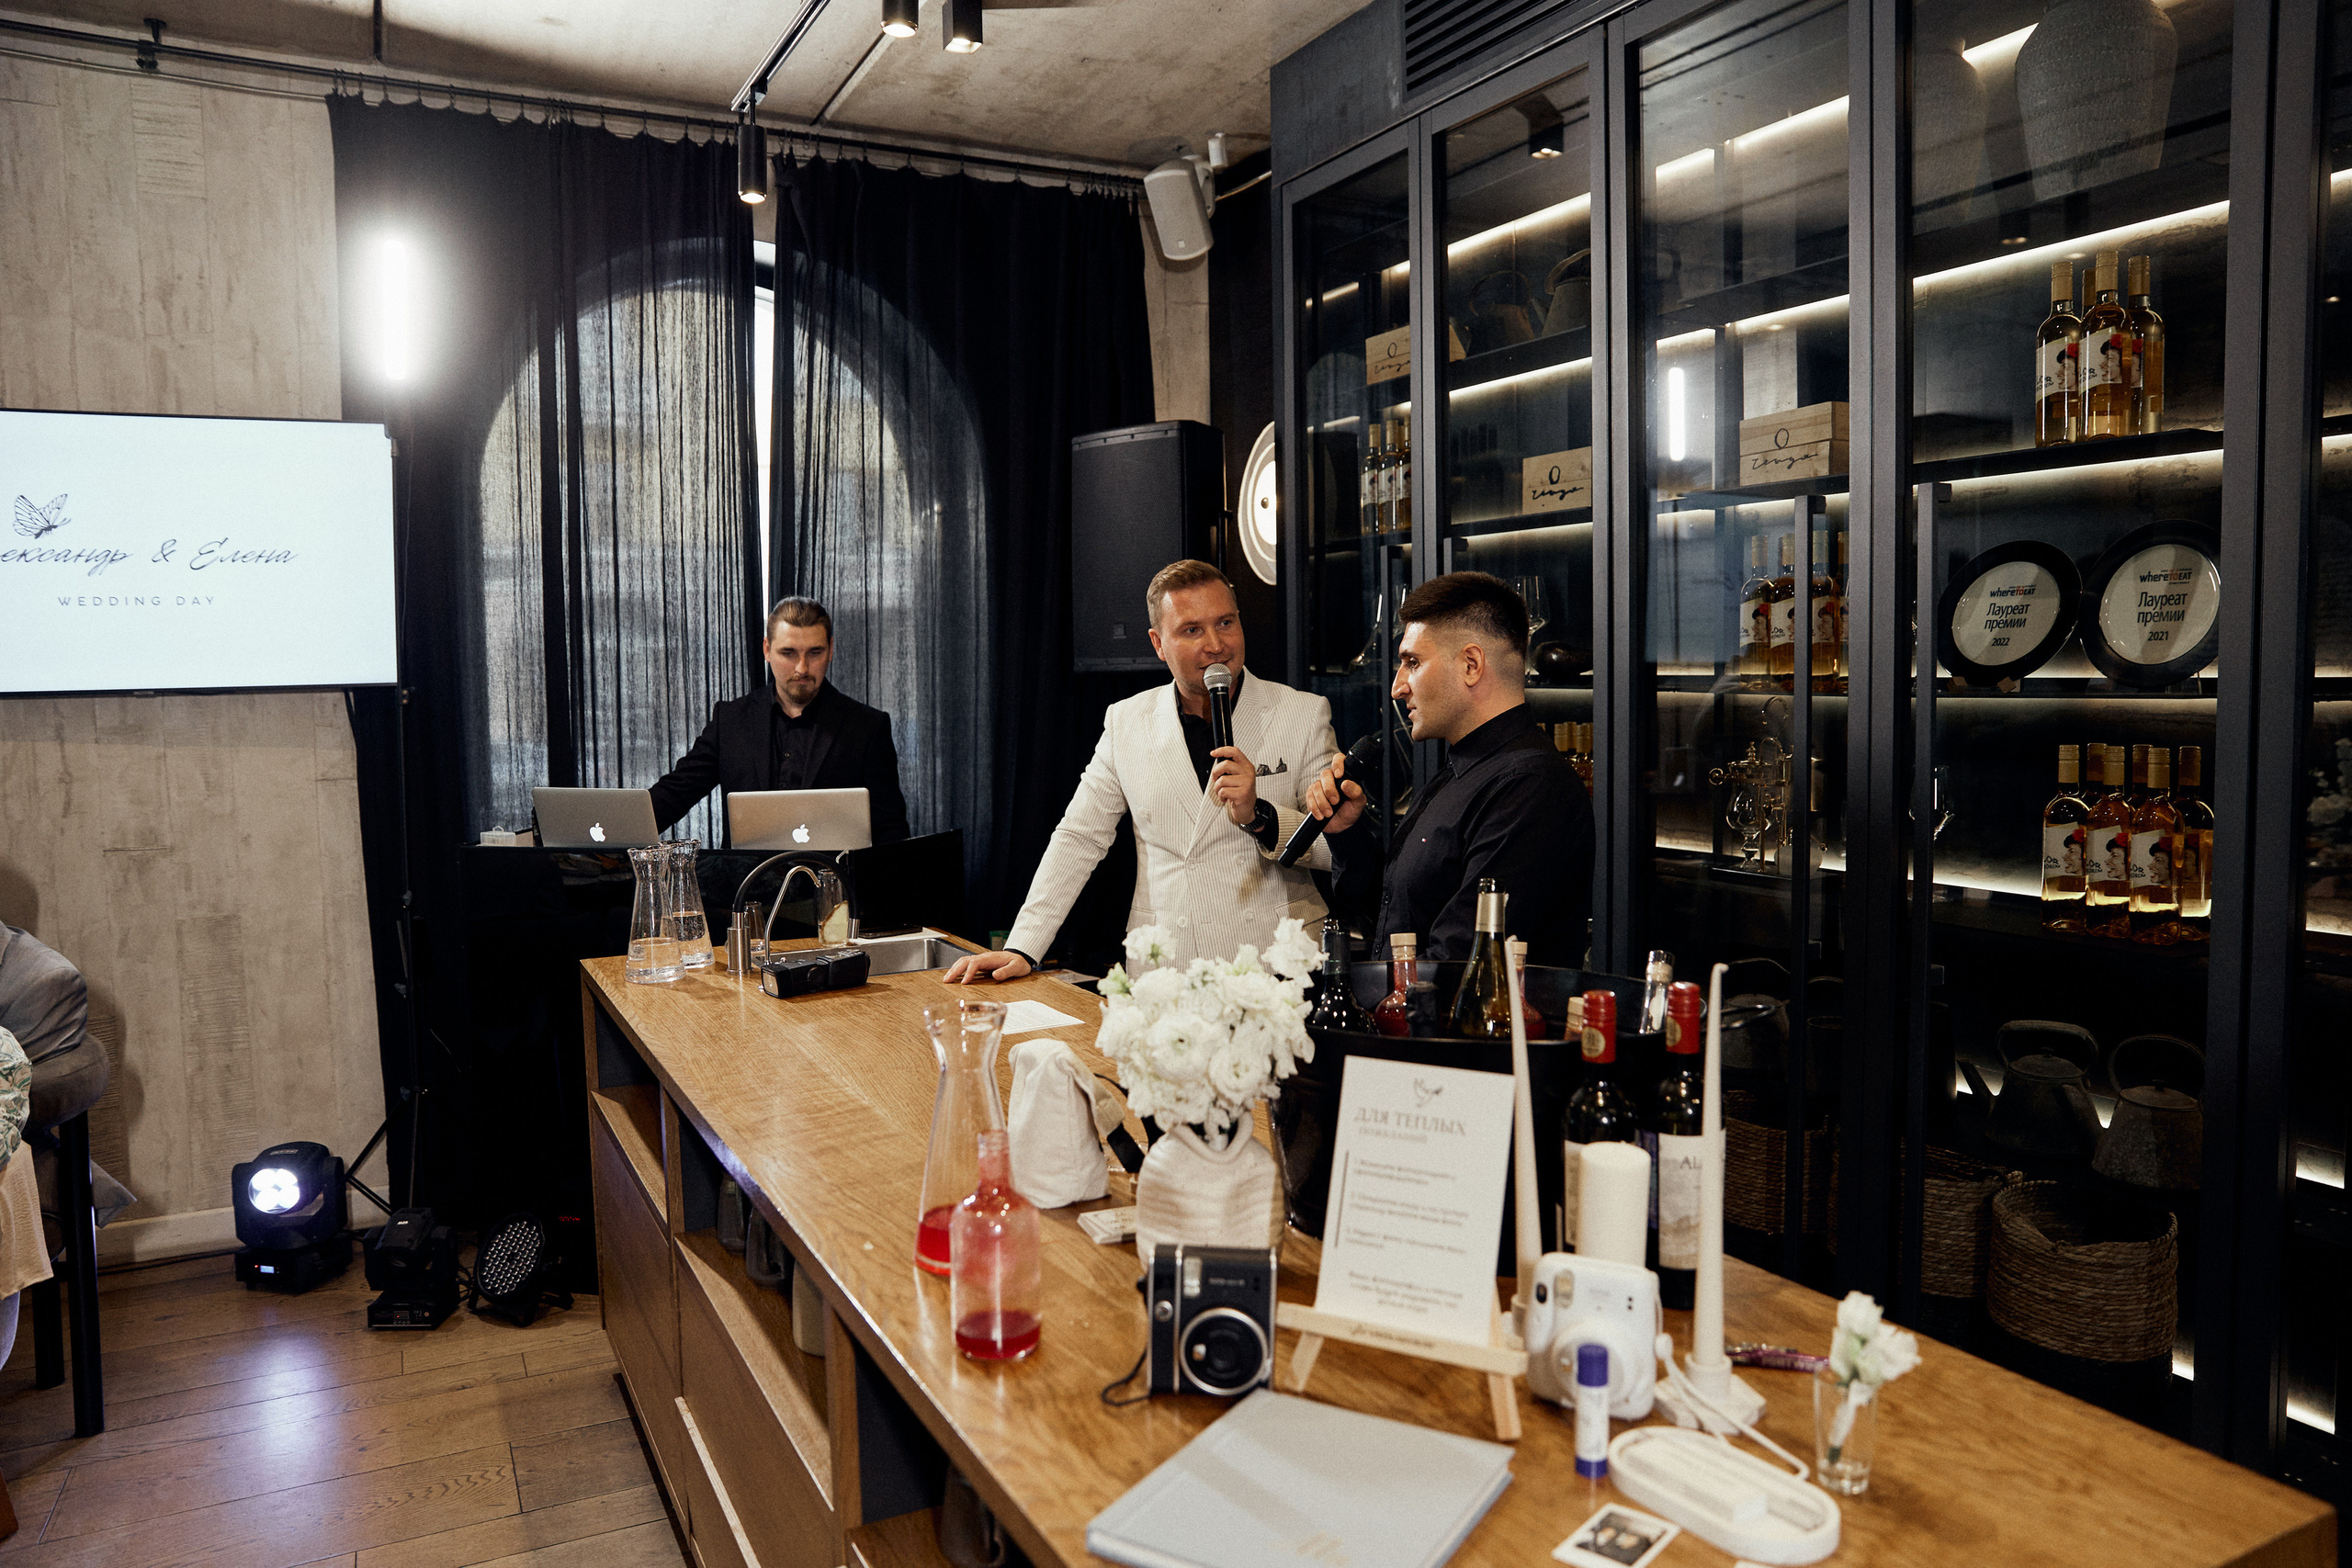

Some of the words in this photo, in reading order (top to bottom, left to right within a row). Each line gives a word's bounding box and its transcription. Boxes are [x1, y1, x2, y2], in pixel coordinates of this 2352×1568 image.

[0, 547, 132, 577] ександр
[150, 538, 177, 563] &
[189, 537, 299, 570] Елена
[57, 595, 163, 607] WEDDING
[175, 595, 216, 606] DAY
[2137, 592, 2188, 611] Лауреат
[1986, 603, 2030, 619] Лауреат
[2137, 610, 2185, 626] премии
[1984, 618, 2027, 632] премии
[1991, 637, 2010, 647] 2022
[2147, 631, 2169, 641] 2021
[1353, 1107, 1389, 1125] ДЛЯ
